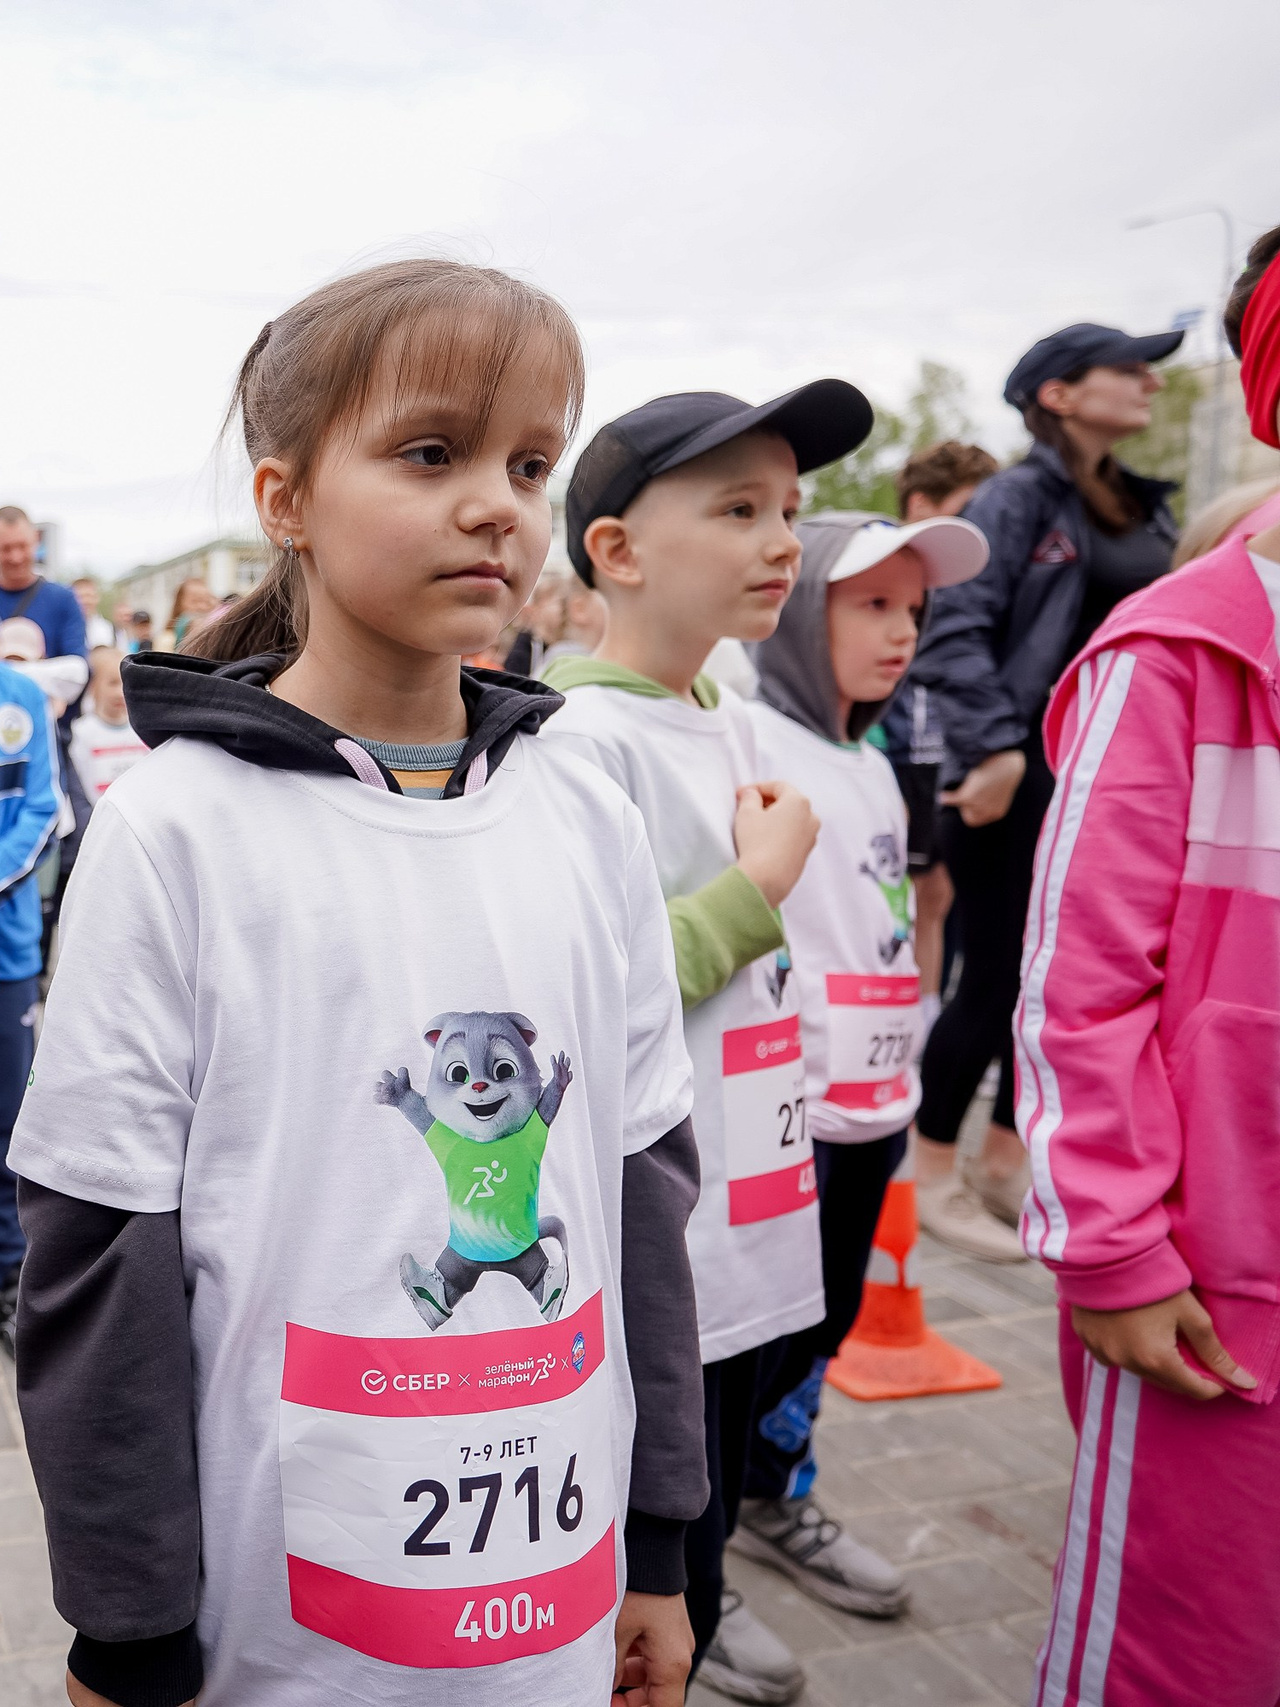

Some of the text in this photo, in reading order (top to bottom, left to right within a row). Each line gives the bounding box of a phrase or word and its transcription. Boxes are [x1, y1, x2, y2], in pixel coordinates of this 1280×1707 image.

[484, 1356, 535, 1376] зелёный
[392, 1372, 451, 1391] СБЕР
[478, 1372, 531, 1389] марафон
[460, 1435, 538, 1465] 7-9 ЛЕТ
[403, 1452, 584, 1556] 2716
